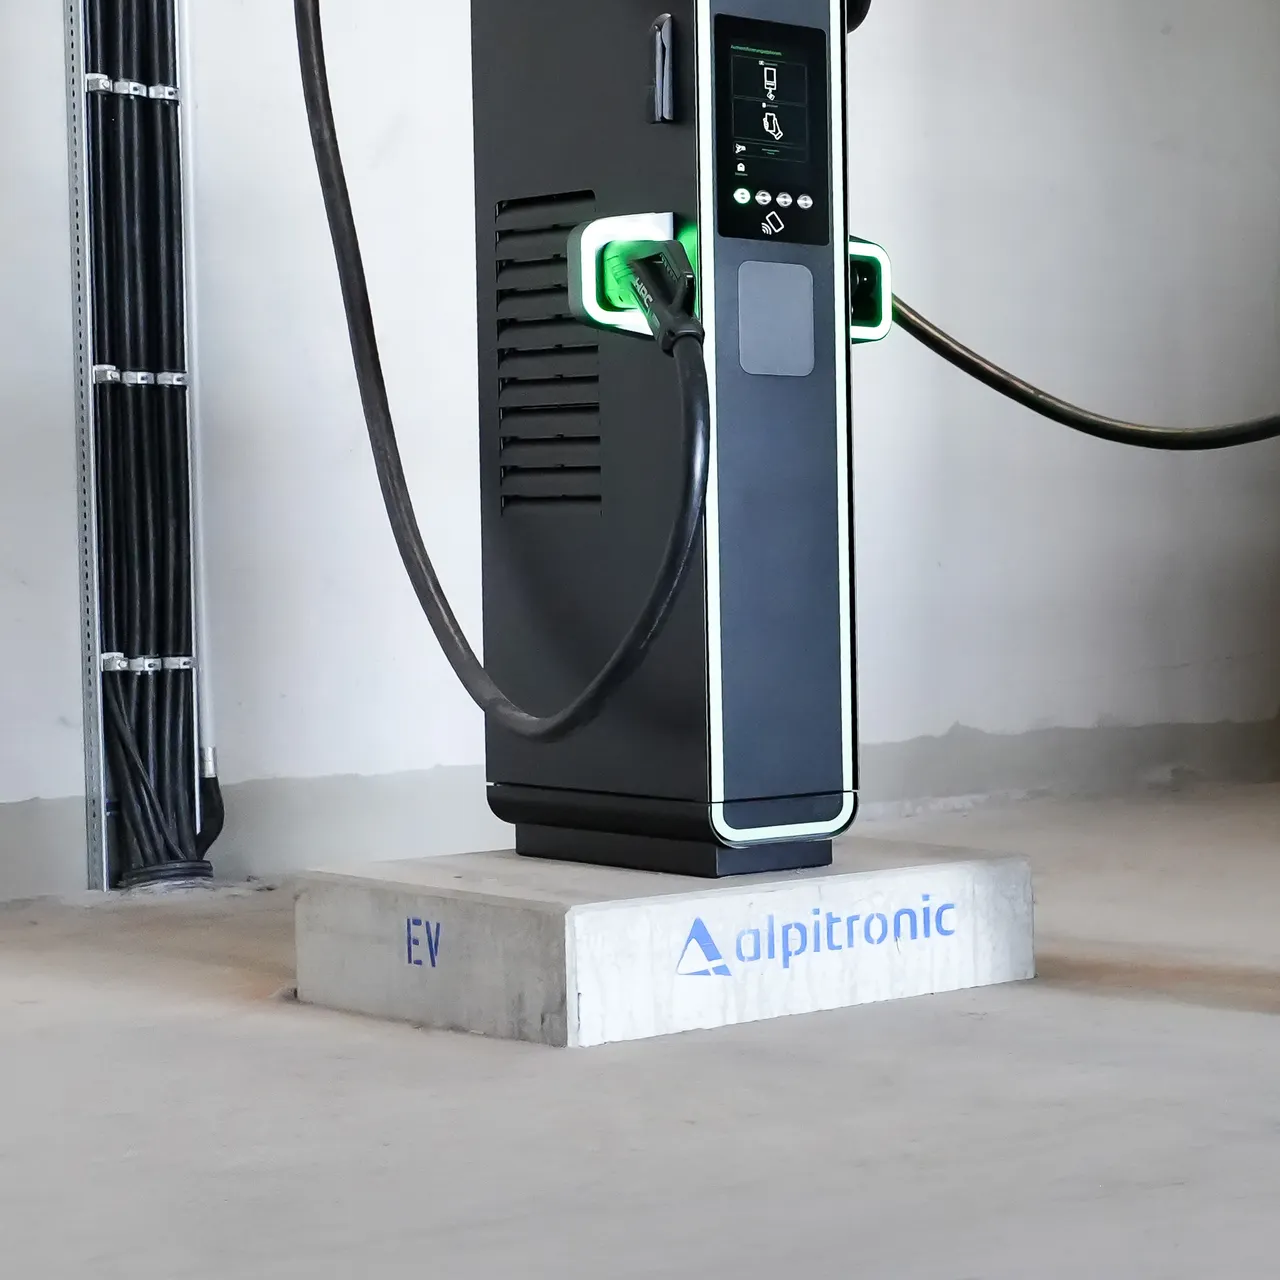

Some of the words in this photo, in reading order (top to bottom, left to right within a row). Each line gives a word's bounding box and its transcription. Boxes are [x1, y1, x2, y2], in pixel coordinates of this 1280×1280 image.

[633, 277, 654, 308] HPC
[406, 918, 441, 968] EV
[735, 893, 956, 969] alpitronic
